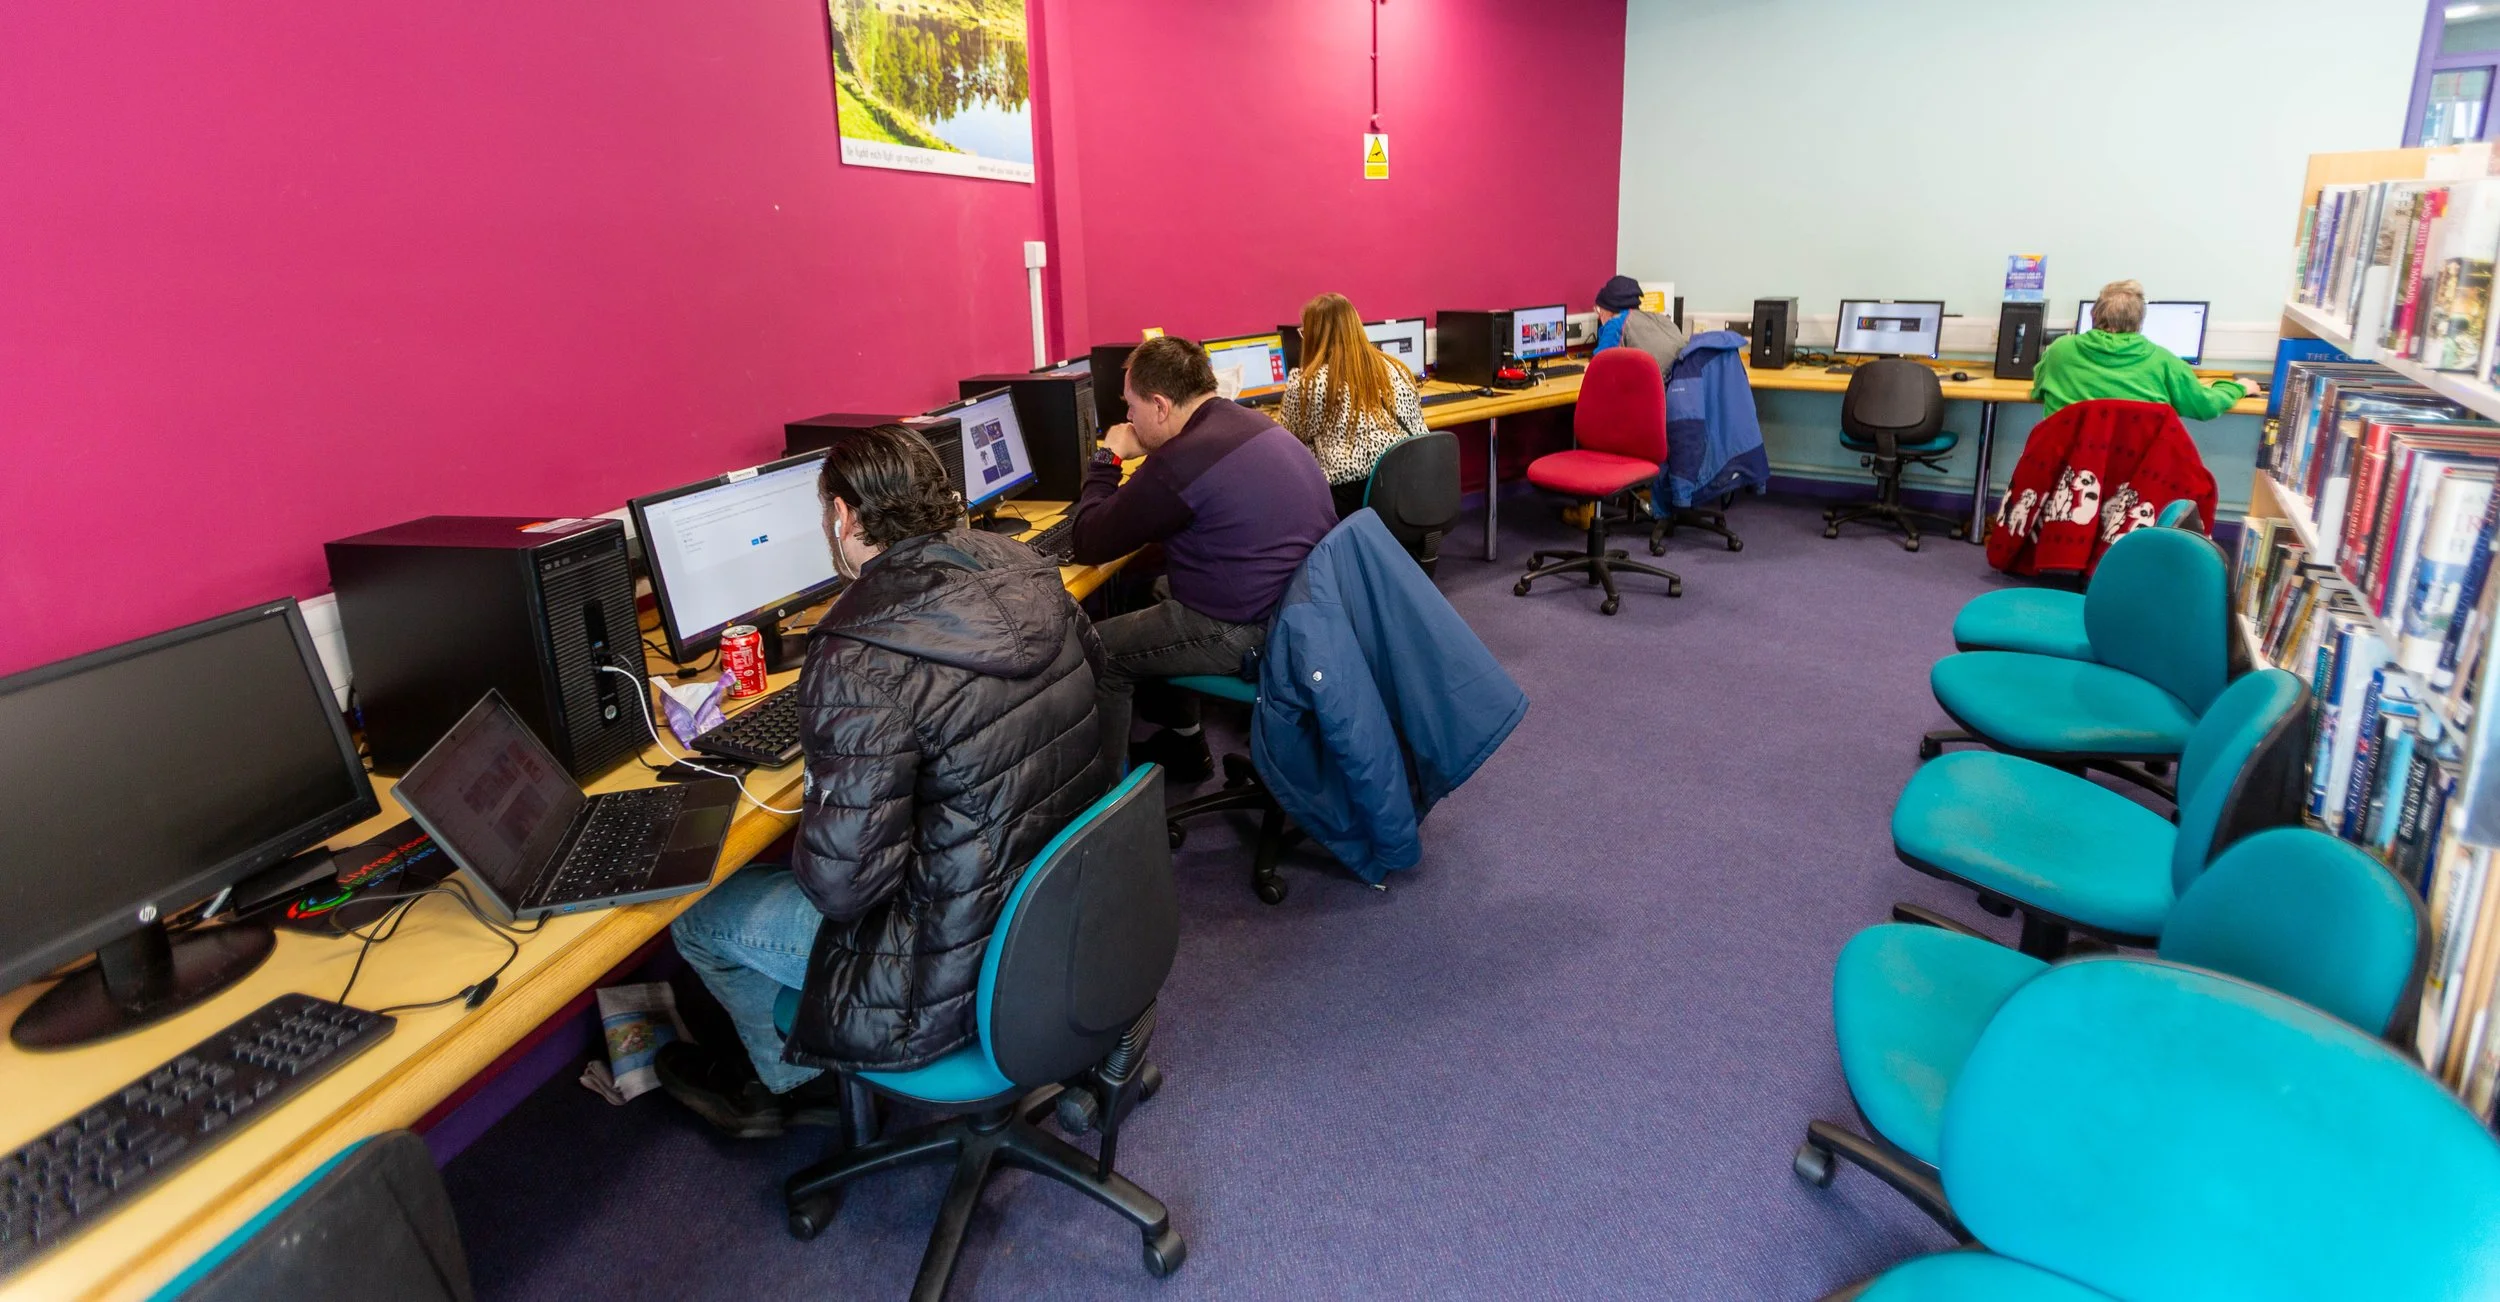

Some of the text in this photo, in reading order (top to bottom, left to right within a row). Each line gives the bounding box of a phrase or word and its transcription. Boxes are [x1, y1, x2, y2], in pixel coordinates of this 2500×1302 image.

[2416, 222, 2429, 245] WITH
[2414, 246, 2426, 265] THE
[2404, 266, 2420, 304] MAQUIS
[2305, 352, 2331, 361] THE
[2347, 759, 2366, 814] BRITAIN
